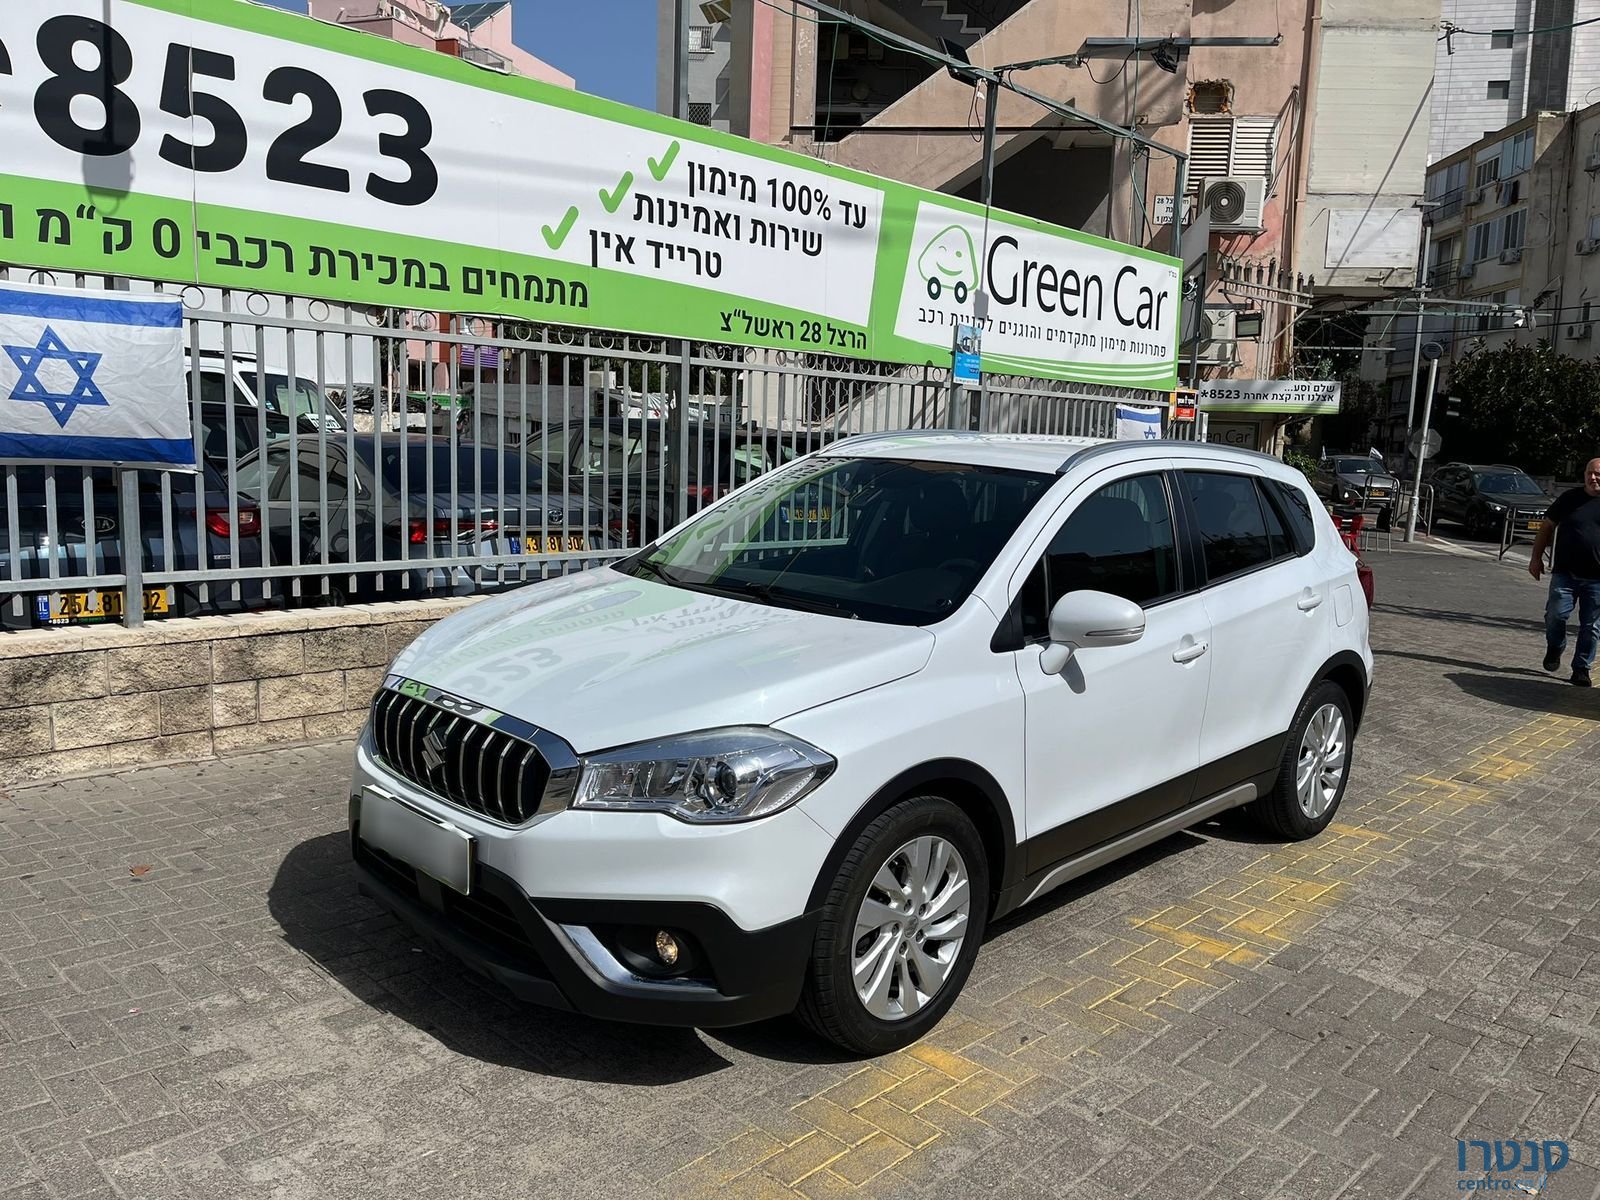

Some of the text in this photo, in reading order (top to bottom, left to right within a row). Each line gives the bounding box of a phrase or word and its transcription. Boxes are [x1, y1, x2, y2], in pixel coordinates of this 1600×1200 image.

[0, 15, 438, 206] 8523
[687, 161, 867, 229] עד 100% מימון
[633, 193, 822, 256] שירות ואמינות
[197, 230, 294, 273] רכבי
[589, 230, 722, 278] טרייד אין
[309, 245, 450, 291] במכירת
[462, 266, 588, 308] מתמחים
[987, 235, 1168, 331] Green Car
[918, 308, 944, 325] רכב
[720, 308, 867, 350] הרצל 28 ראשל"צ
[999, 320, 1041, 339] והוגנים
[1046, 328, 1096, 349] מתקדמים
[1100, 336, 1127, 352] מימון
[1129, 340, 1167, 358] פתרונות
[1243, 392, 1269, 400] אחרת
[1271, 393, 1291, 403] קצת
[1294, 393, 1305, 401] זה
[1307, 393, 1334, 402] אצלנו
[1313, 384, 1335, 392] שלם
[1225, 429, 1251, 443] Car
